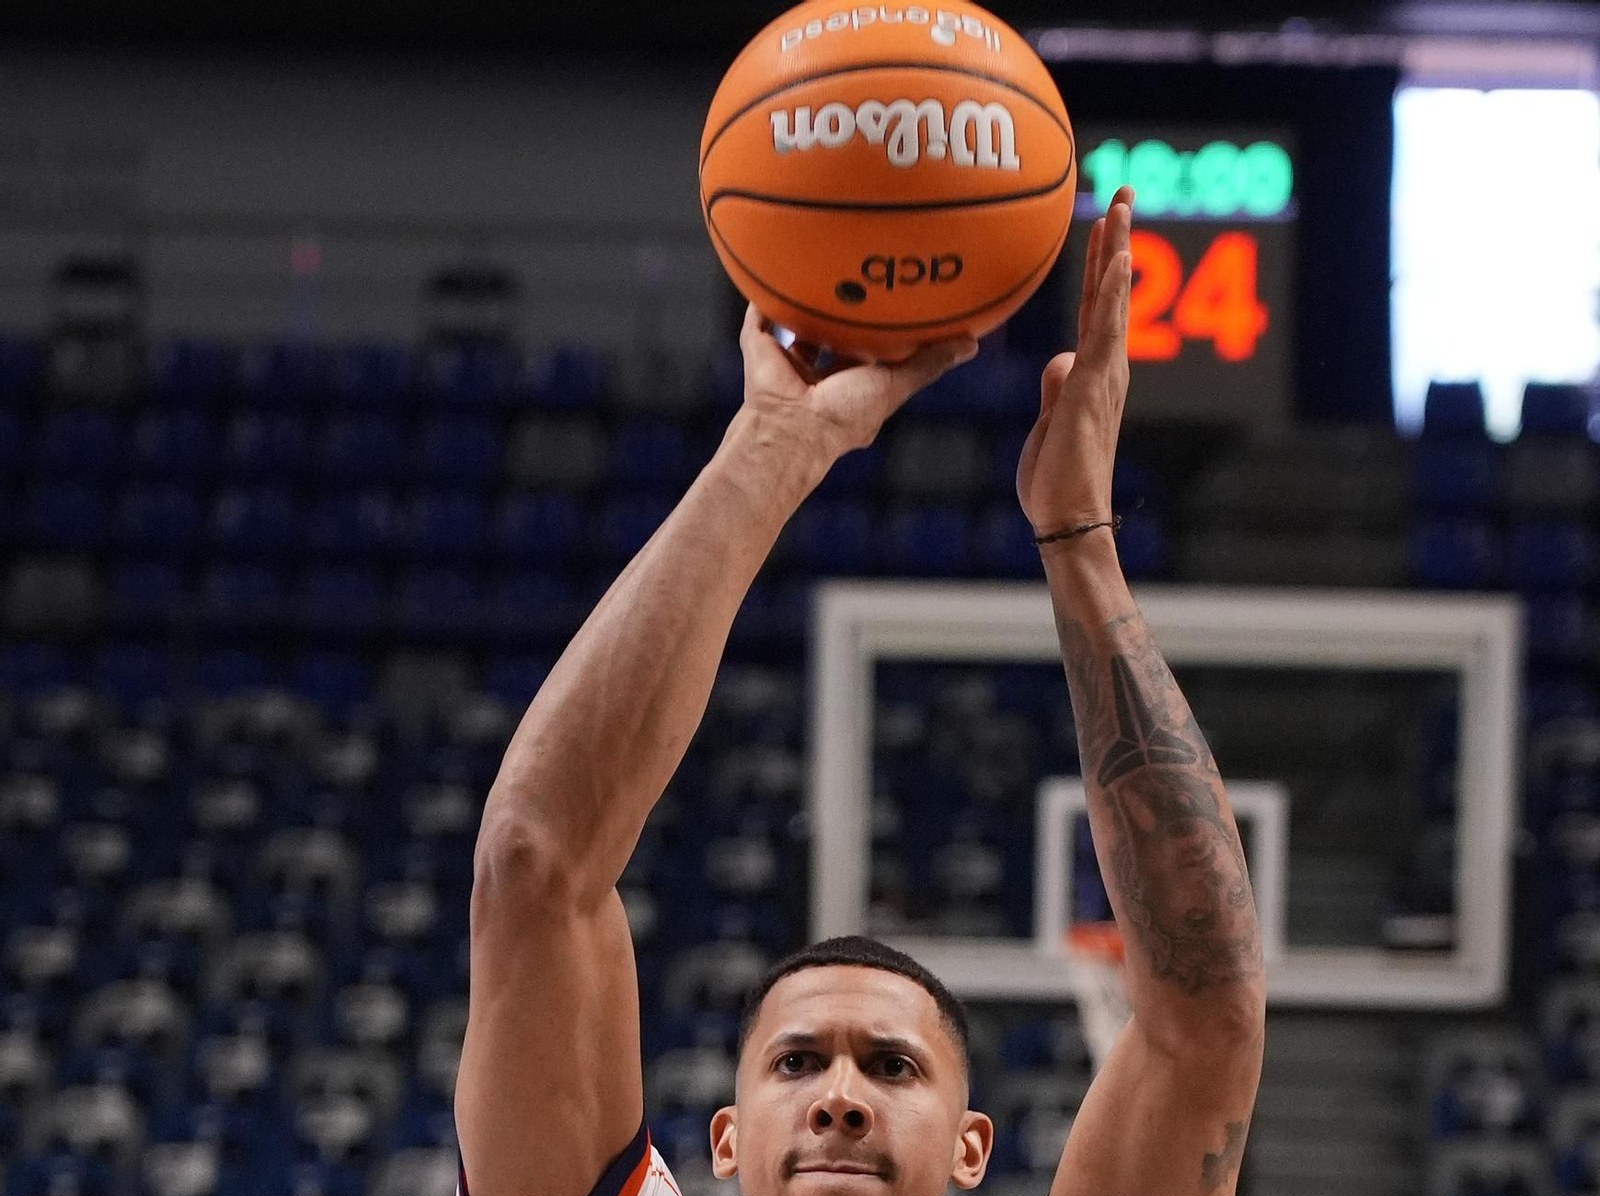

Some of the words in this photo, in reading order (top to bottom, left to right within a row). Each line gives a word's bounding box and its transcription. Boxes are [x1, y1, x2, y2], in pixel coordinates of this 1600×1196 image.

[770, 98, 1020, 172] Wilson
[860, 253, 963, 292] acb
[1126, 229, 1269, 362] 24
